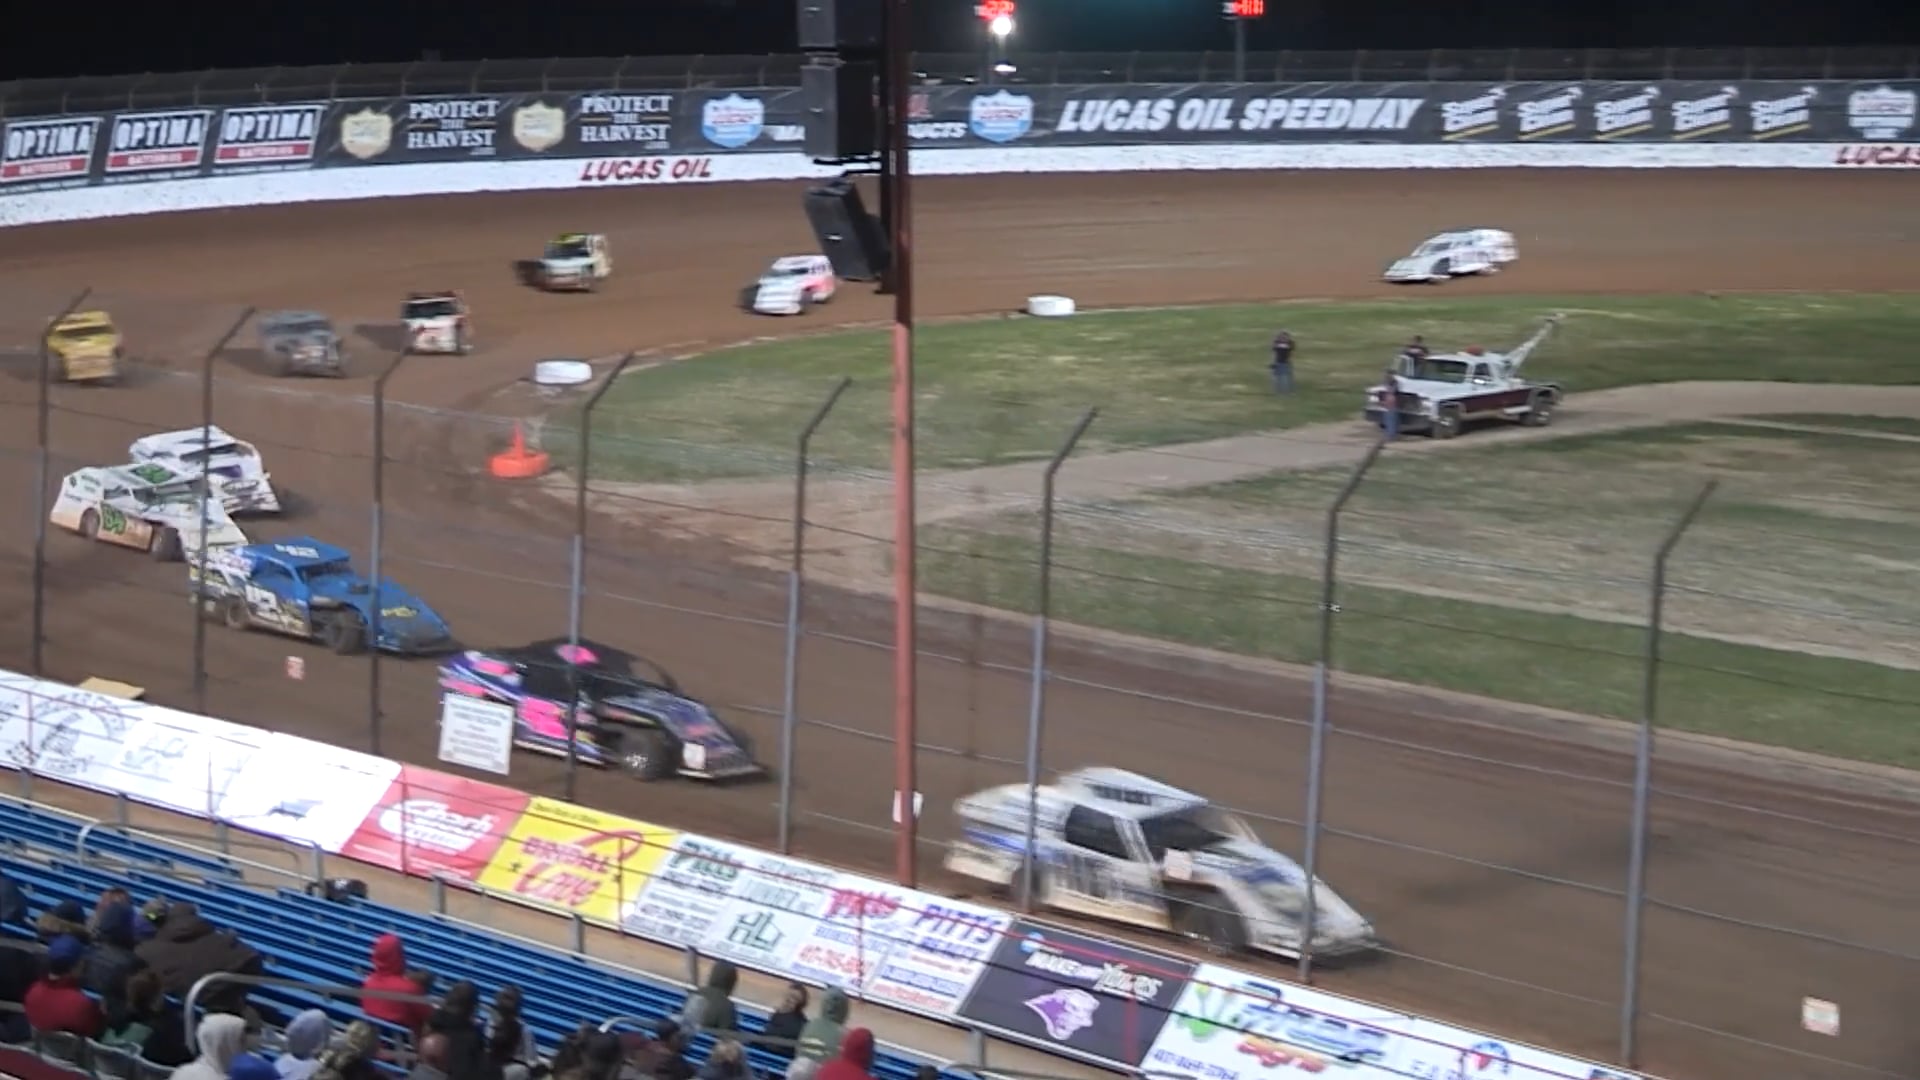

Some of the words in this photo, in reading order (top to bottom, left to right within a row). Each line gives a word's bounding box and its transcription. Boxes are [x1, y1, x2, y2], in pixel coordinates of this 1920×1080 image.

[408, 99, 499, 120] PROTECT
[579, 95, 673, 114] PROTECT
[1056, 99, 1176, 132] LUCAS
[1176, 98, 1237, 131] OIL
[1238, 98, 1425, 130] SPEEDWAY
[114, 117, 202, 149] OPTIMA
[224, 112, 314, 142] OPTIMA
[406, 129, 497, 149] HARVEST
[579, 124, 672, 143] HARVEST
[7, 124, 92, 159] OPTIMA
[580, 159, 664, 182] LUCAS
[671, 158, 712, 179] OIL
[915, 903, 1003, 943] PITTS
